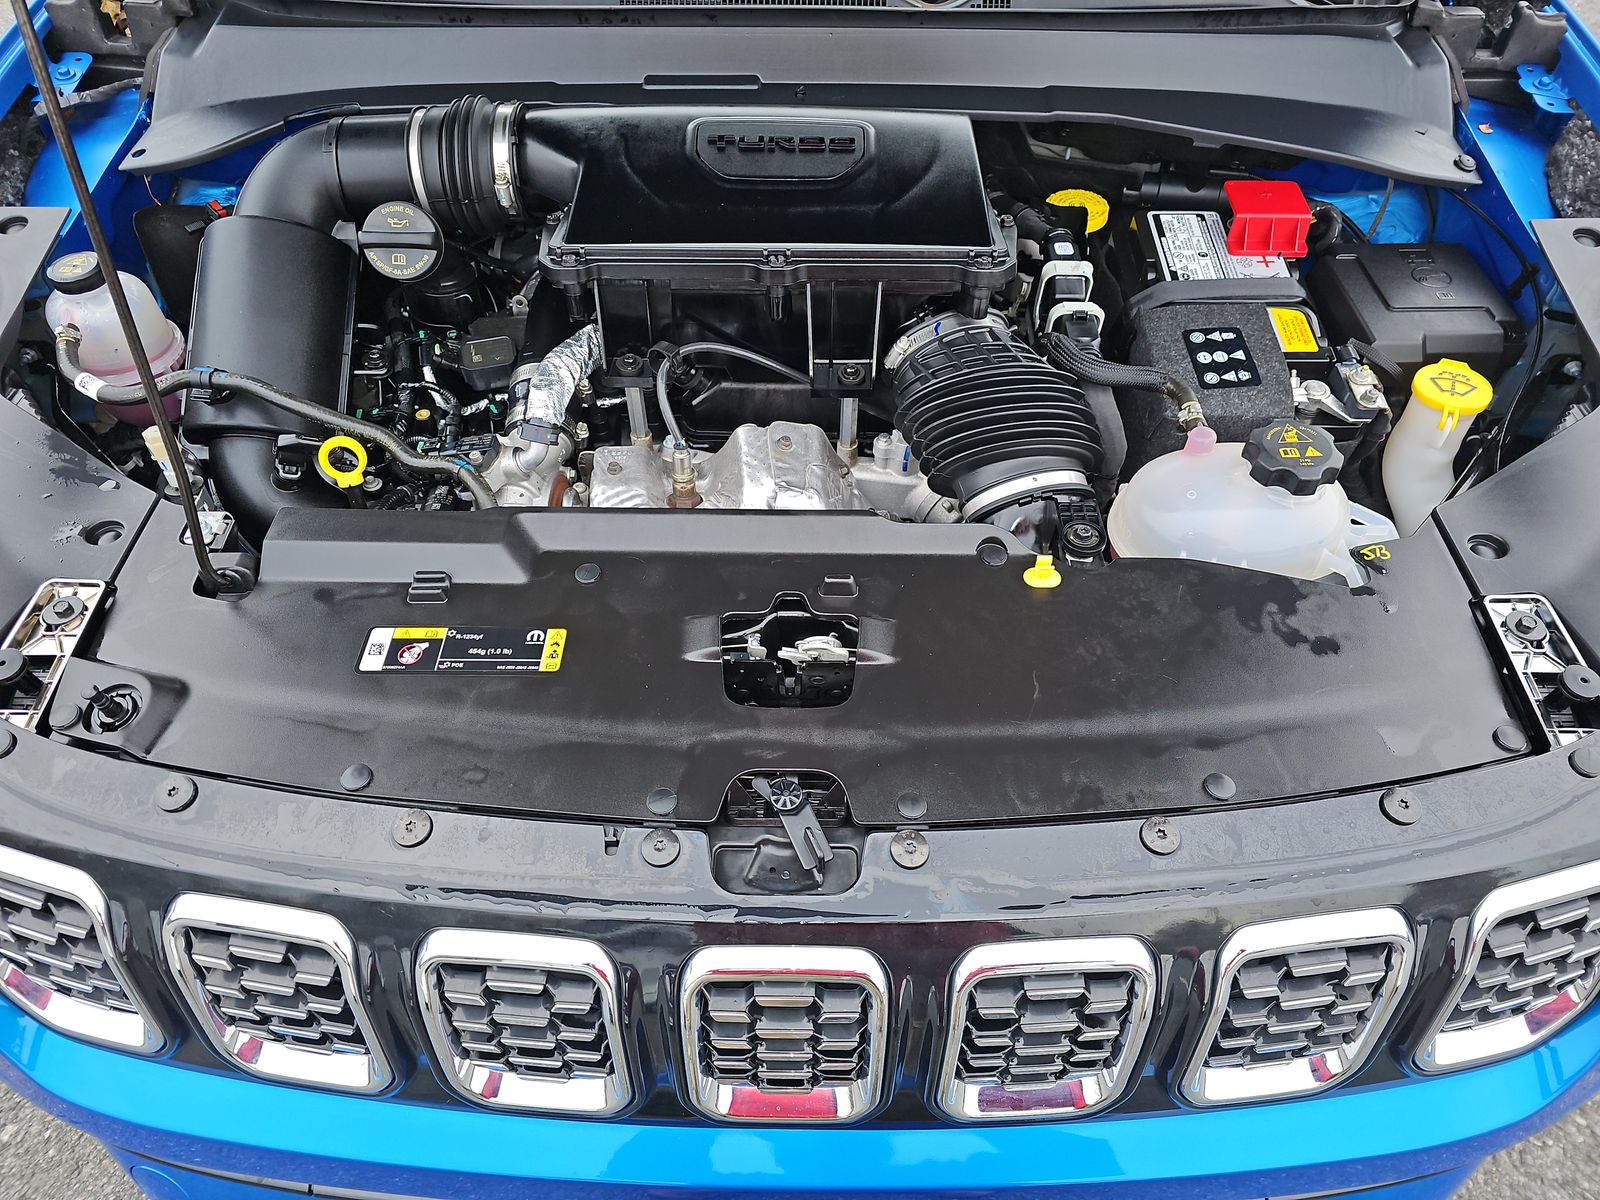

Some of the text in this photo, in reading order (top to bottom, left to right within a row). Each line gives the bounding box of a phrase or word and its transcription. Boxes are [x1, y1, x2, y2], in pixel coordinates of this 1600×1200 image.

[707, 134, 856, 152] TURBO
[381, 205, 415, 217] ENGINE OIL
[467, 648, 513, 656] 454g (1.0 lb)
